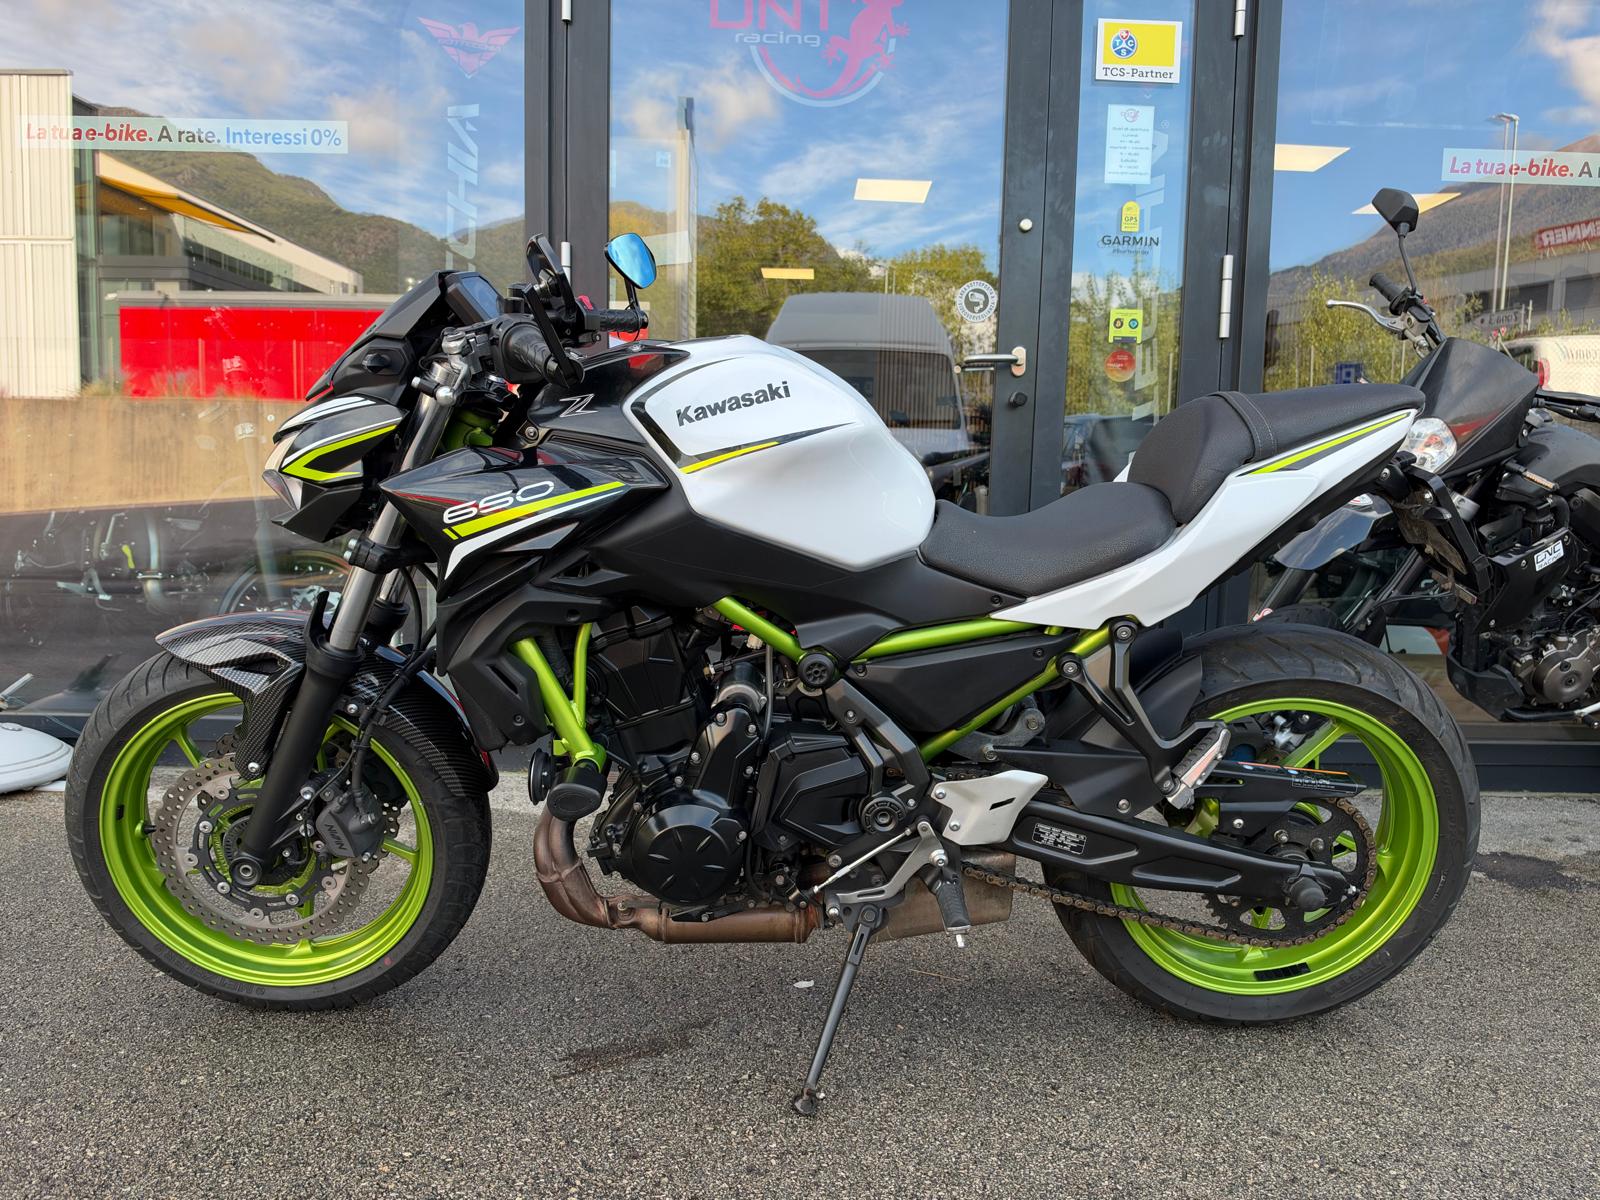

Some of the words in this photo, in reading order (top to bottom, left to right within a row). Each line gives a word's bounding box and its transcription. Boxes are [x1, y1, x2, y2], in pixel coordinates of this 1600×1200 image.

[735, 31, 821, 48] racing
[1102, 66, 1174, 80] TCS-Partner
[26, 122, 47, 140] La
[50, 124, 82, 141] tua
[85, 123, 154, 143] e-bike.
[157, 125, 173, 144] A
[177, 126, 222, 144] rate.
[225, 126, 307, 146] Interessi
[310, 128, 342, 147] 0%
[1450, 156, 1472, 174] La
[1475, 159, 1506, 176] tua
[1508, 157, 1574, 178] e-bike.
[1578, 161, 1593, 178] A
[1101, 235, 1160, 247] GARMIN
[675, 380, 791, 427] Kawasaki
[443, 480, 555, 524] 650
[1536, 541, 1561, 565] CNC
